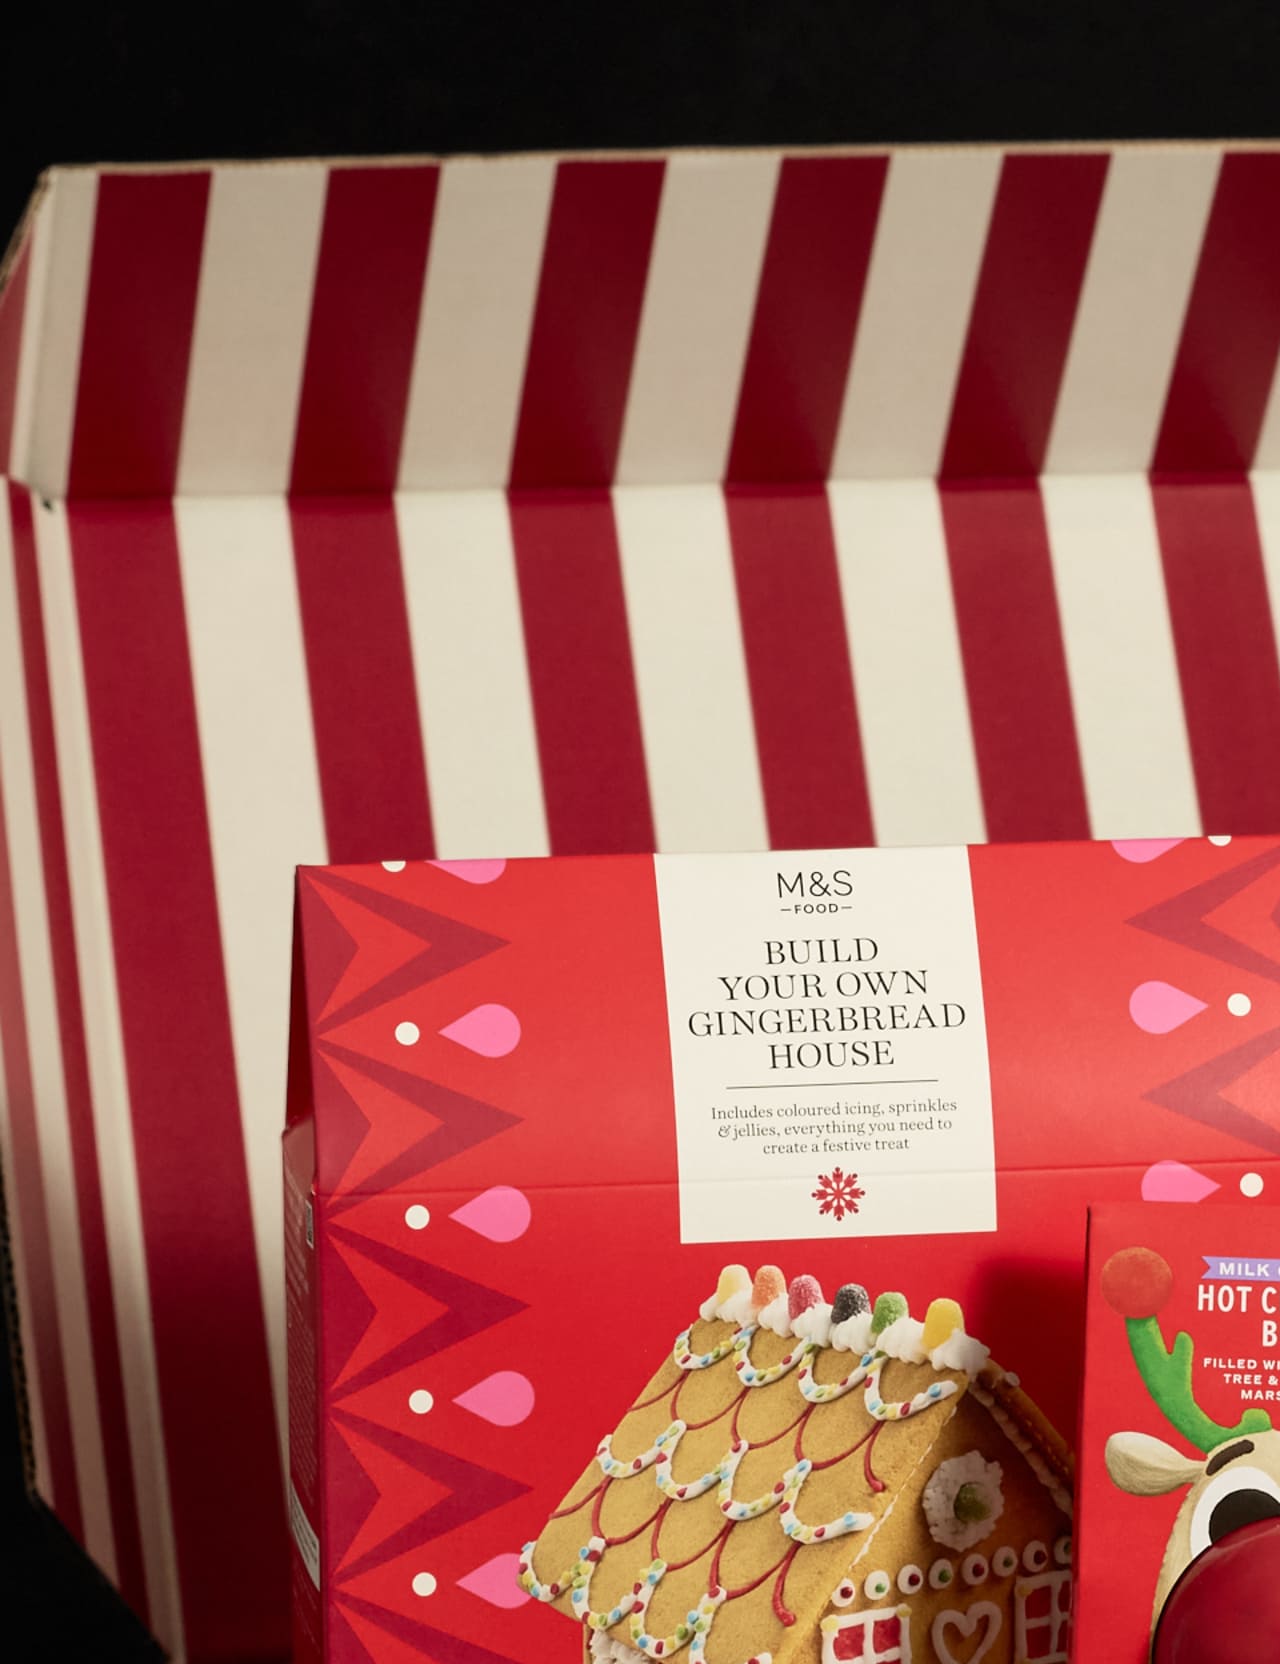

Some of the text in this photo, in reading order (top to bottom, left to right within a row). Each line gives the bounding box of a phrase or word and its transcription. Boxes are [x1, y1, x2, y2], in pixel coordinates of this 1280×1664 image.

[777, 871, 852, 898] M&S
[766, 939, 877, 964] BUILD
[719, 971, 926, 1000] YOUR OWN
[689, 1004, 965, 1036] GINGERBREAD
[770, 1041, 893, 1068] HOUSE
[712, 1098, 957, 1119] Includes coloured icing, sprinkles
[718, 1117, 952, 1140] & jellies, everything you need to
[763, 1139, 909, 1154] create a festive treat
[1219, 1262, 1270, 1277] MILK
[1198, 1285, 1252, 1312] HOT
[1204, 1358, 1257, 1369] FILLED
[1224, 1374, 1261, 1384] TREE
[1268, 1376, 1278, 1385] &
